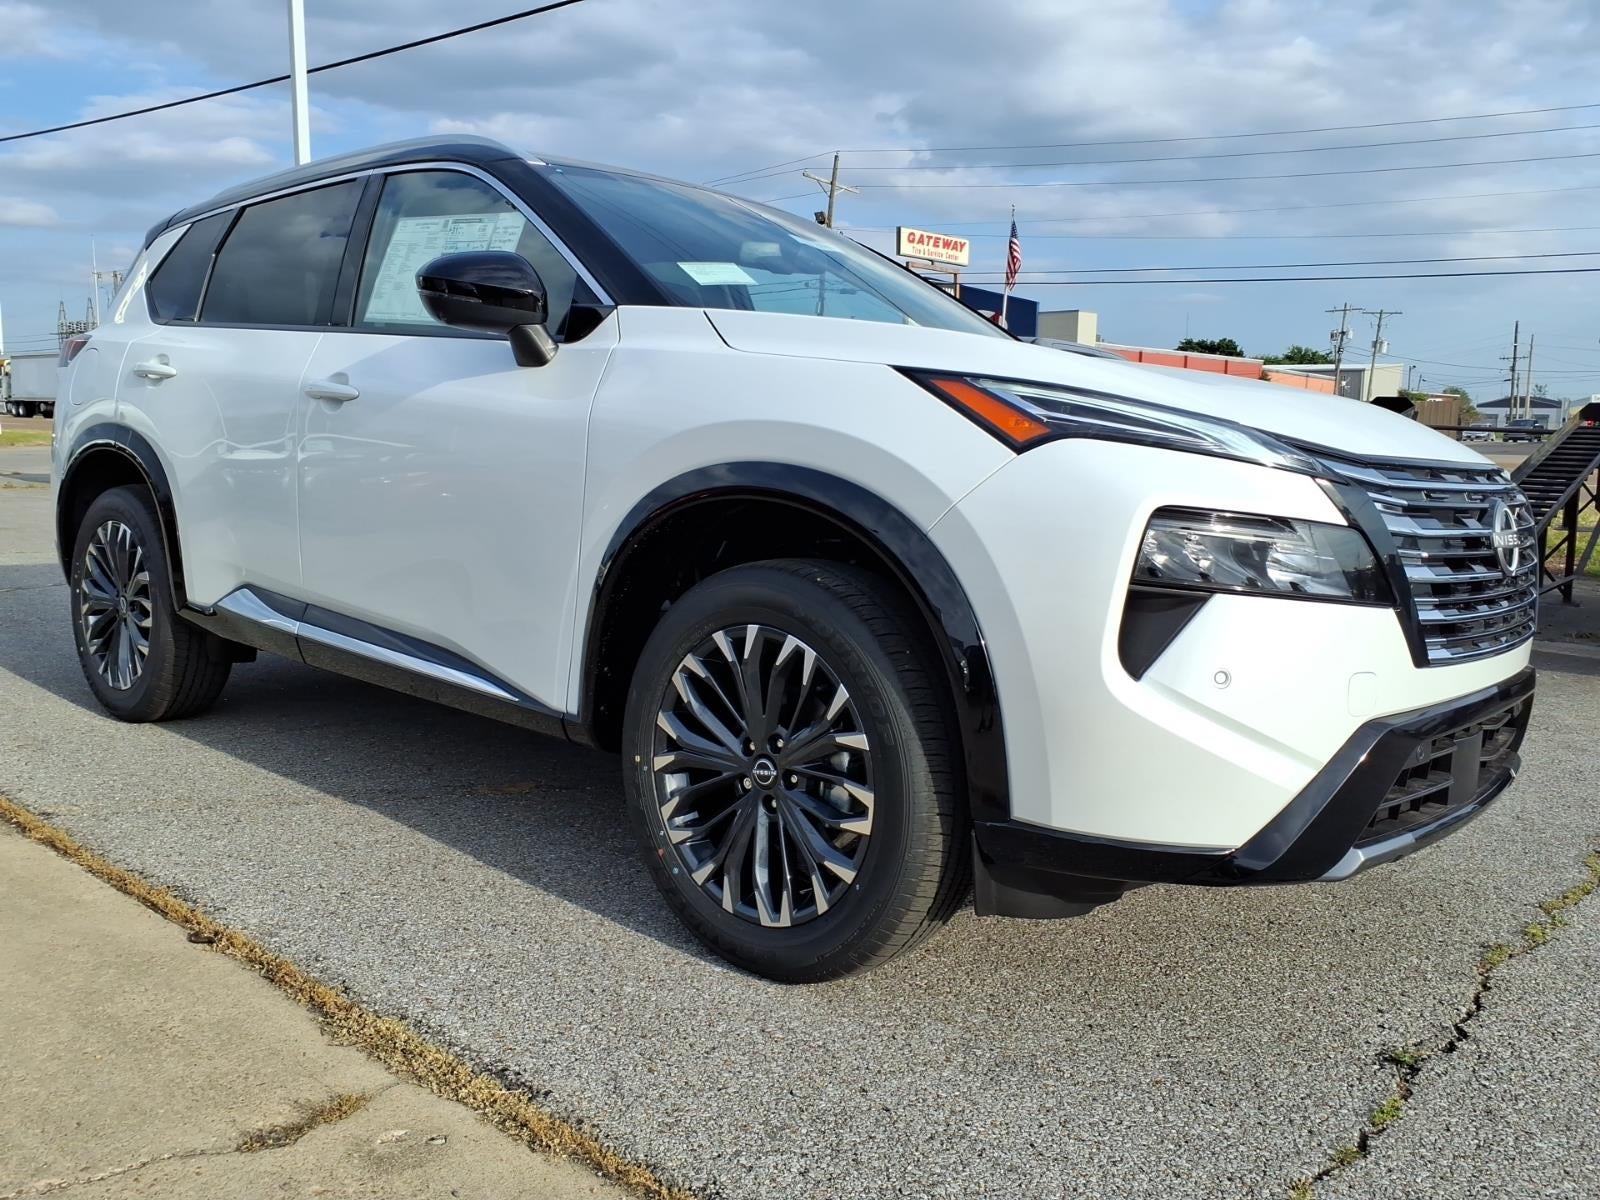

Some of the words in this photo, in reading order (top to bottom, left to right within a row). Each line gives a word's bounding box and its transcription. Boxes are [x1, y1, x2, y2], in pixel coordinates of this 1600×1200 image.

[907, 232, 966, 253] GATEWAY
[928, 249, 943, 258] Service
[945, 252, 960, 261] Center
[1495, 534, 1524, 546] NISS
